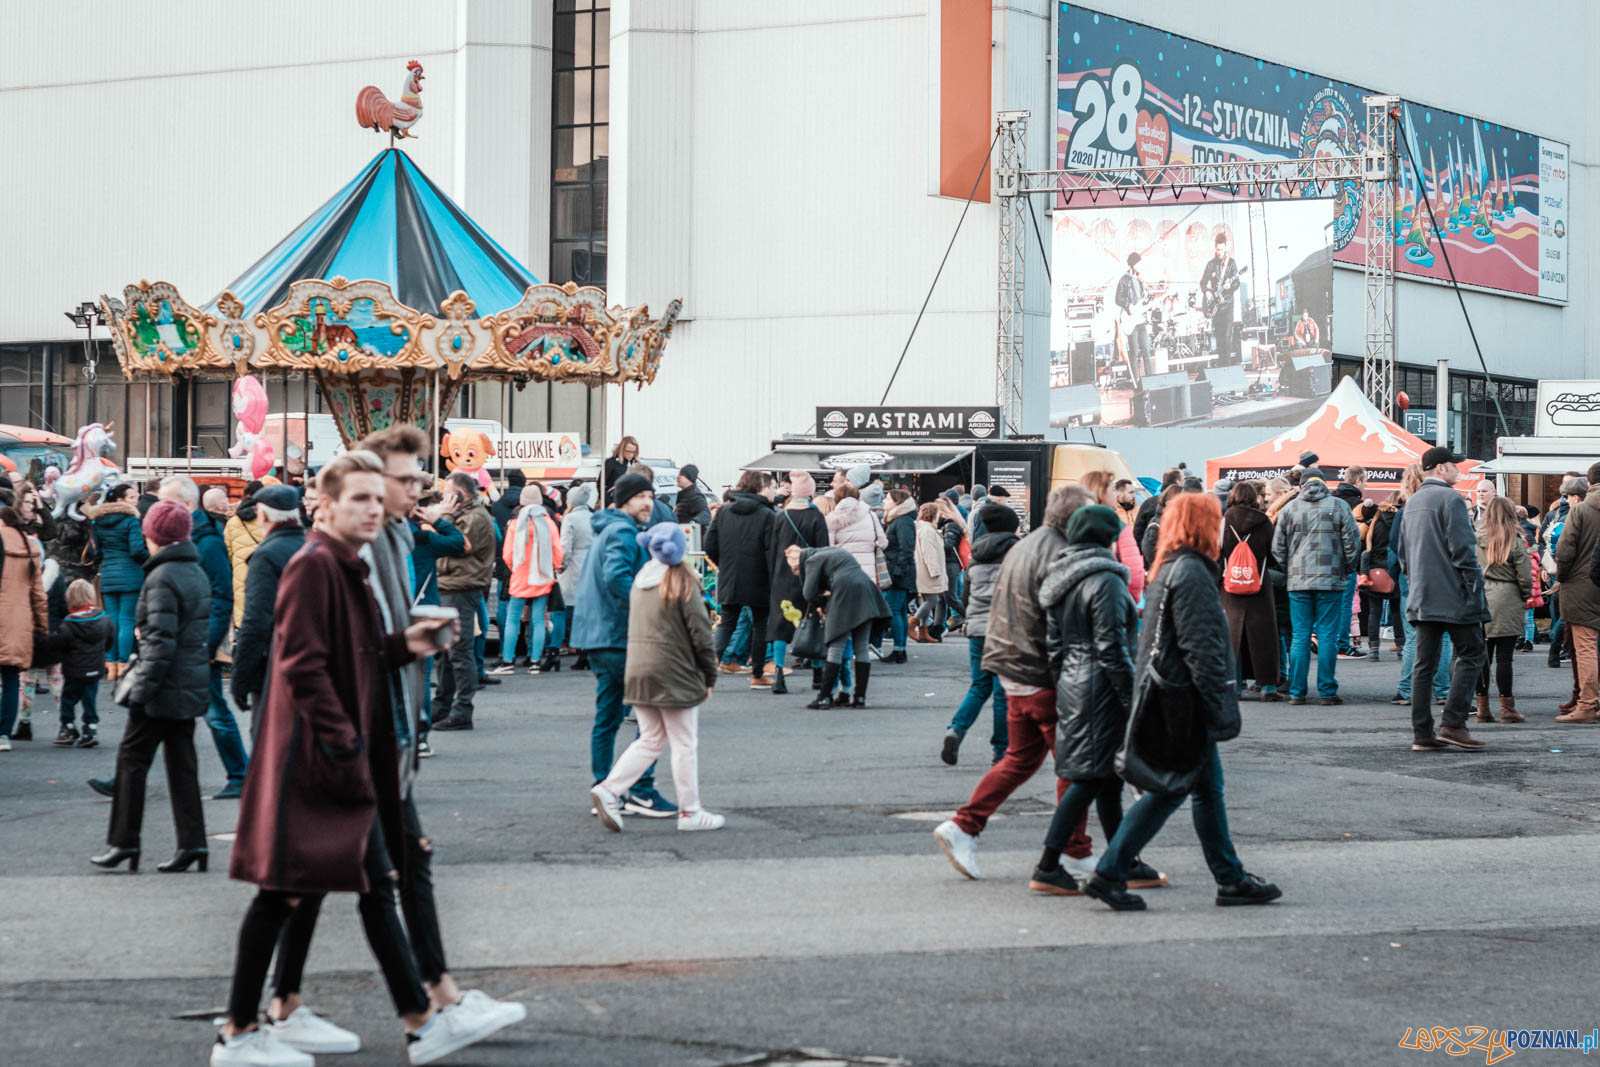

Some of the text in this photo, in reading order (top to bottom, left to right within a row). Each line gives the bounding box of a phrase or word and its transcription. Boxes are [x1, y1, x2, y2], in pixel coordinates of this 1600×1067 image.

[1068, 63, 1142, 160] 28
[1182, 93, 1291, 149] 12 STYCZNIA
[1071, 150, 1093, 166] 2020
[853, 412, 964, 430] PASTRAMI
[497, 440, 554, 459] BELGIJSKIE
